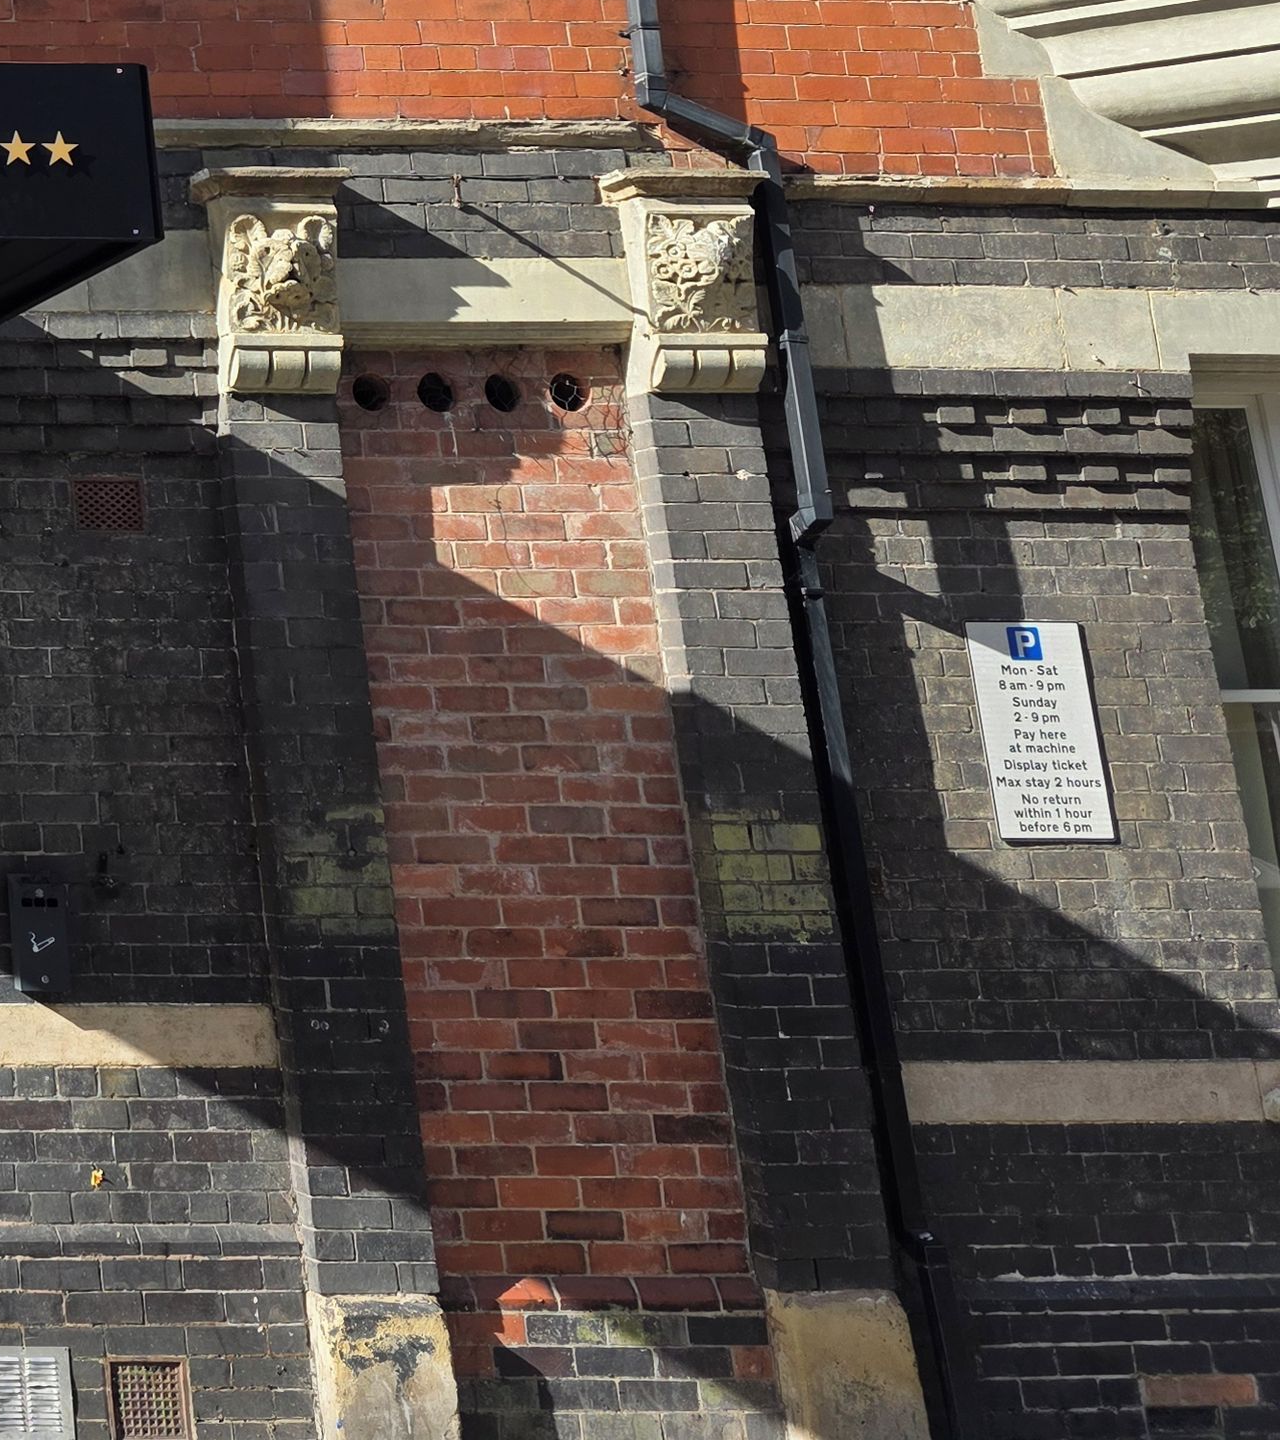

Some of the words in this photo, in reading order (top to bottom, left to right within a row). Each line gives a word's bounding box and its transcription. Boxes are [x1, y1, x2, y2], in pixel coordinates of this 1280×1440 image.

[1014, 630, 1036, 658] P
[1001, 664, 1027, 676] Mon
[1037, 665, 1058, 676] Sat
[998, 679, 1007, 690] 8
[1009, 682, 1028, 691] am
[1036, 680, 1044, 691] 9
[1047, 682, 1066, 692] pm
[1012, 696, 1057, 709] Sunday
[1014, 711, 1022, 722] 2
[1031, 711, 1039, 723] 9
[1042, 714, 1060, 724] pm
[1014, 728, 1035, 741] Pay
[1039, 729, 1067, 740] here
[1009, 742, 1022, 753] at
[1025, 742, 1076, 754] machine
[1003, 759, 1048, 772] Display
[1052, 760, 1088, 771] ticket
[996, 776, 1022, 787] Max
[1026, 777, 1050, 789] stay
[1054, 776, 1063, 787] 2
[1066, 777, 1102, 788] hours
[1021, 793, 1039, 805] No
[1043, 794, 1082, 805] return
[1014, 807, 1052, 819] within
[1055, 808, 1061, 818] 1
[1064, 808, 1093, 819] hour
[1019, 821, 1060, 832] before
[1063, 821, 1071, 832] 6
[1074, 824, 1093, 834] pm
